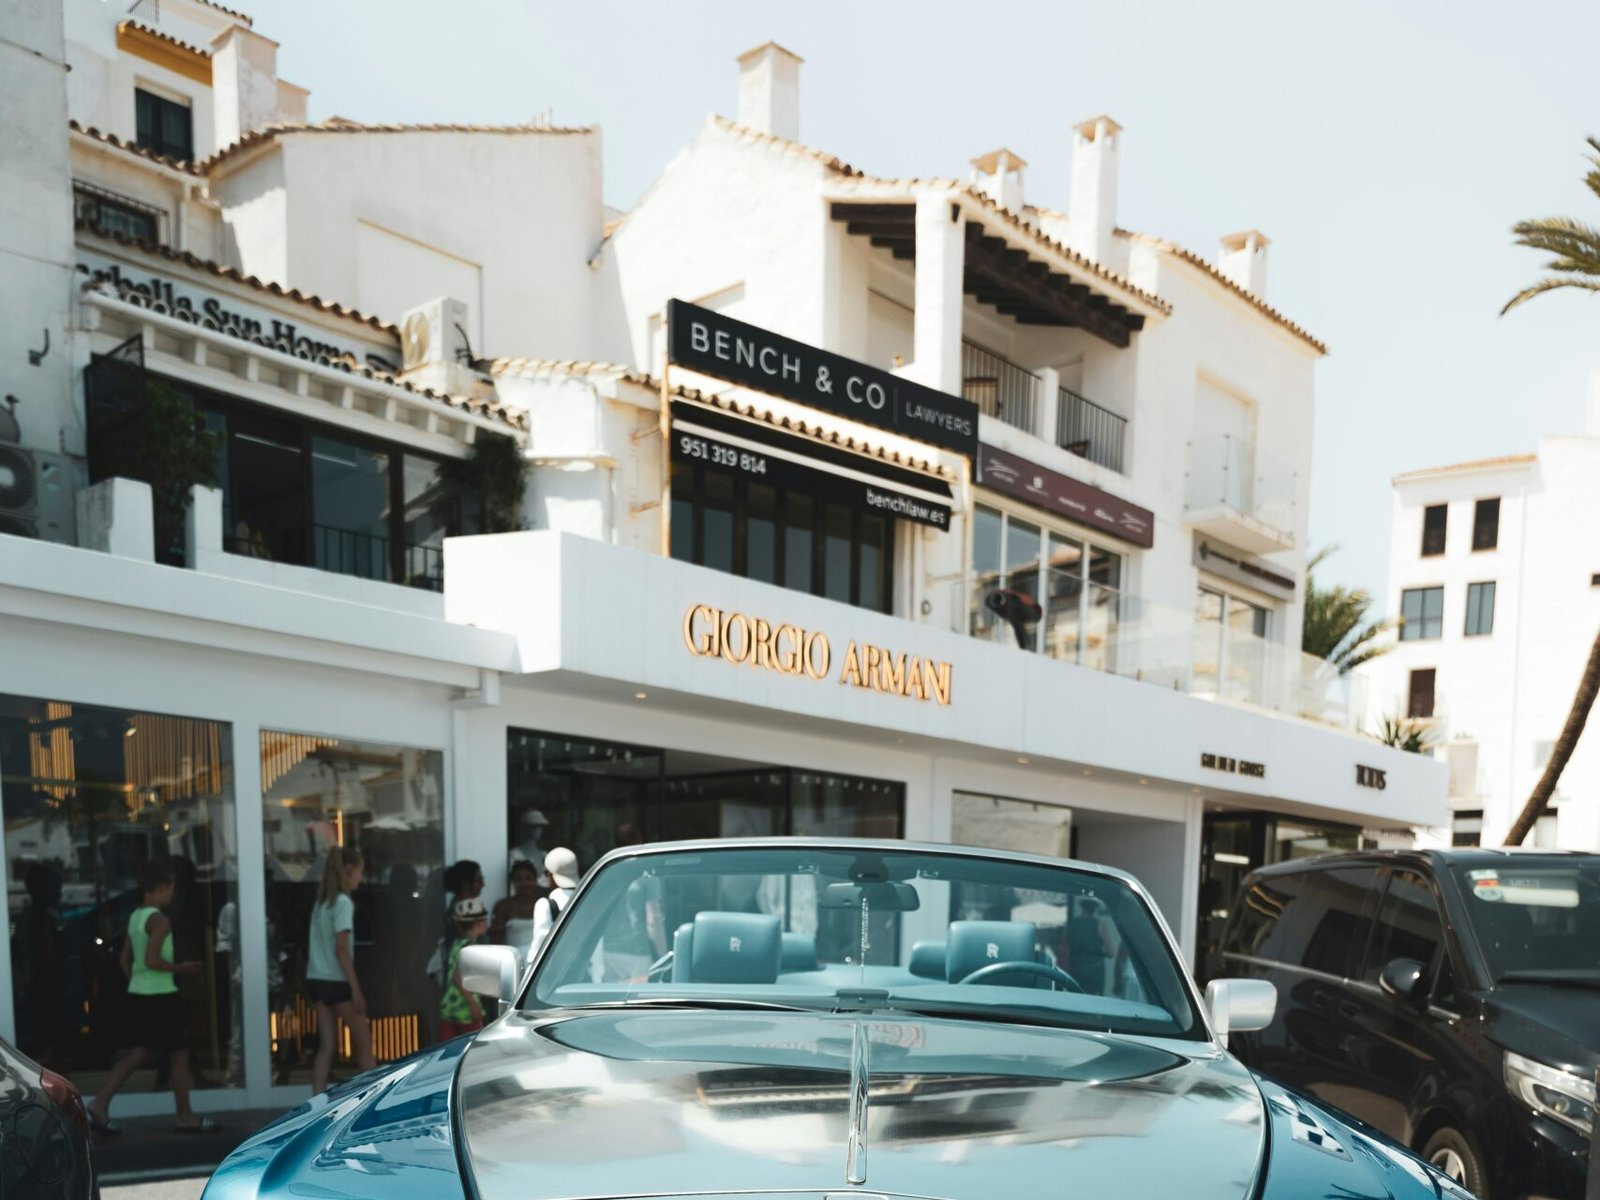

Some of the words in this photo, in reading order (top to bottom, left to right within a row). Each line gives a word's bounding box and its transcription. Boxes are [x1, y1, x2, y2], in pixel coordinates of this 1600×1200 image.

[203, 298, 261, 341] Sun
[271, 319, 356, 364] Hom
[691, 322, 801, 383] BENCH
[815, 366, 833, 394] &
[846, 376, 886, 410] CO
[905, 401, 973, 436] LAWYERS
[680, 436, 708, 460] 951
[711, 445, 739, 467] 319
[740, 453, 766, 475] 814
[866, 488, 945, 524] benchlaw.es
[683, 603, 831, 680] GIORGIO
[839, 639, 953, 705] ARMANI
